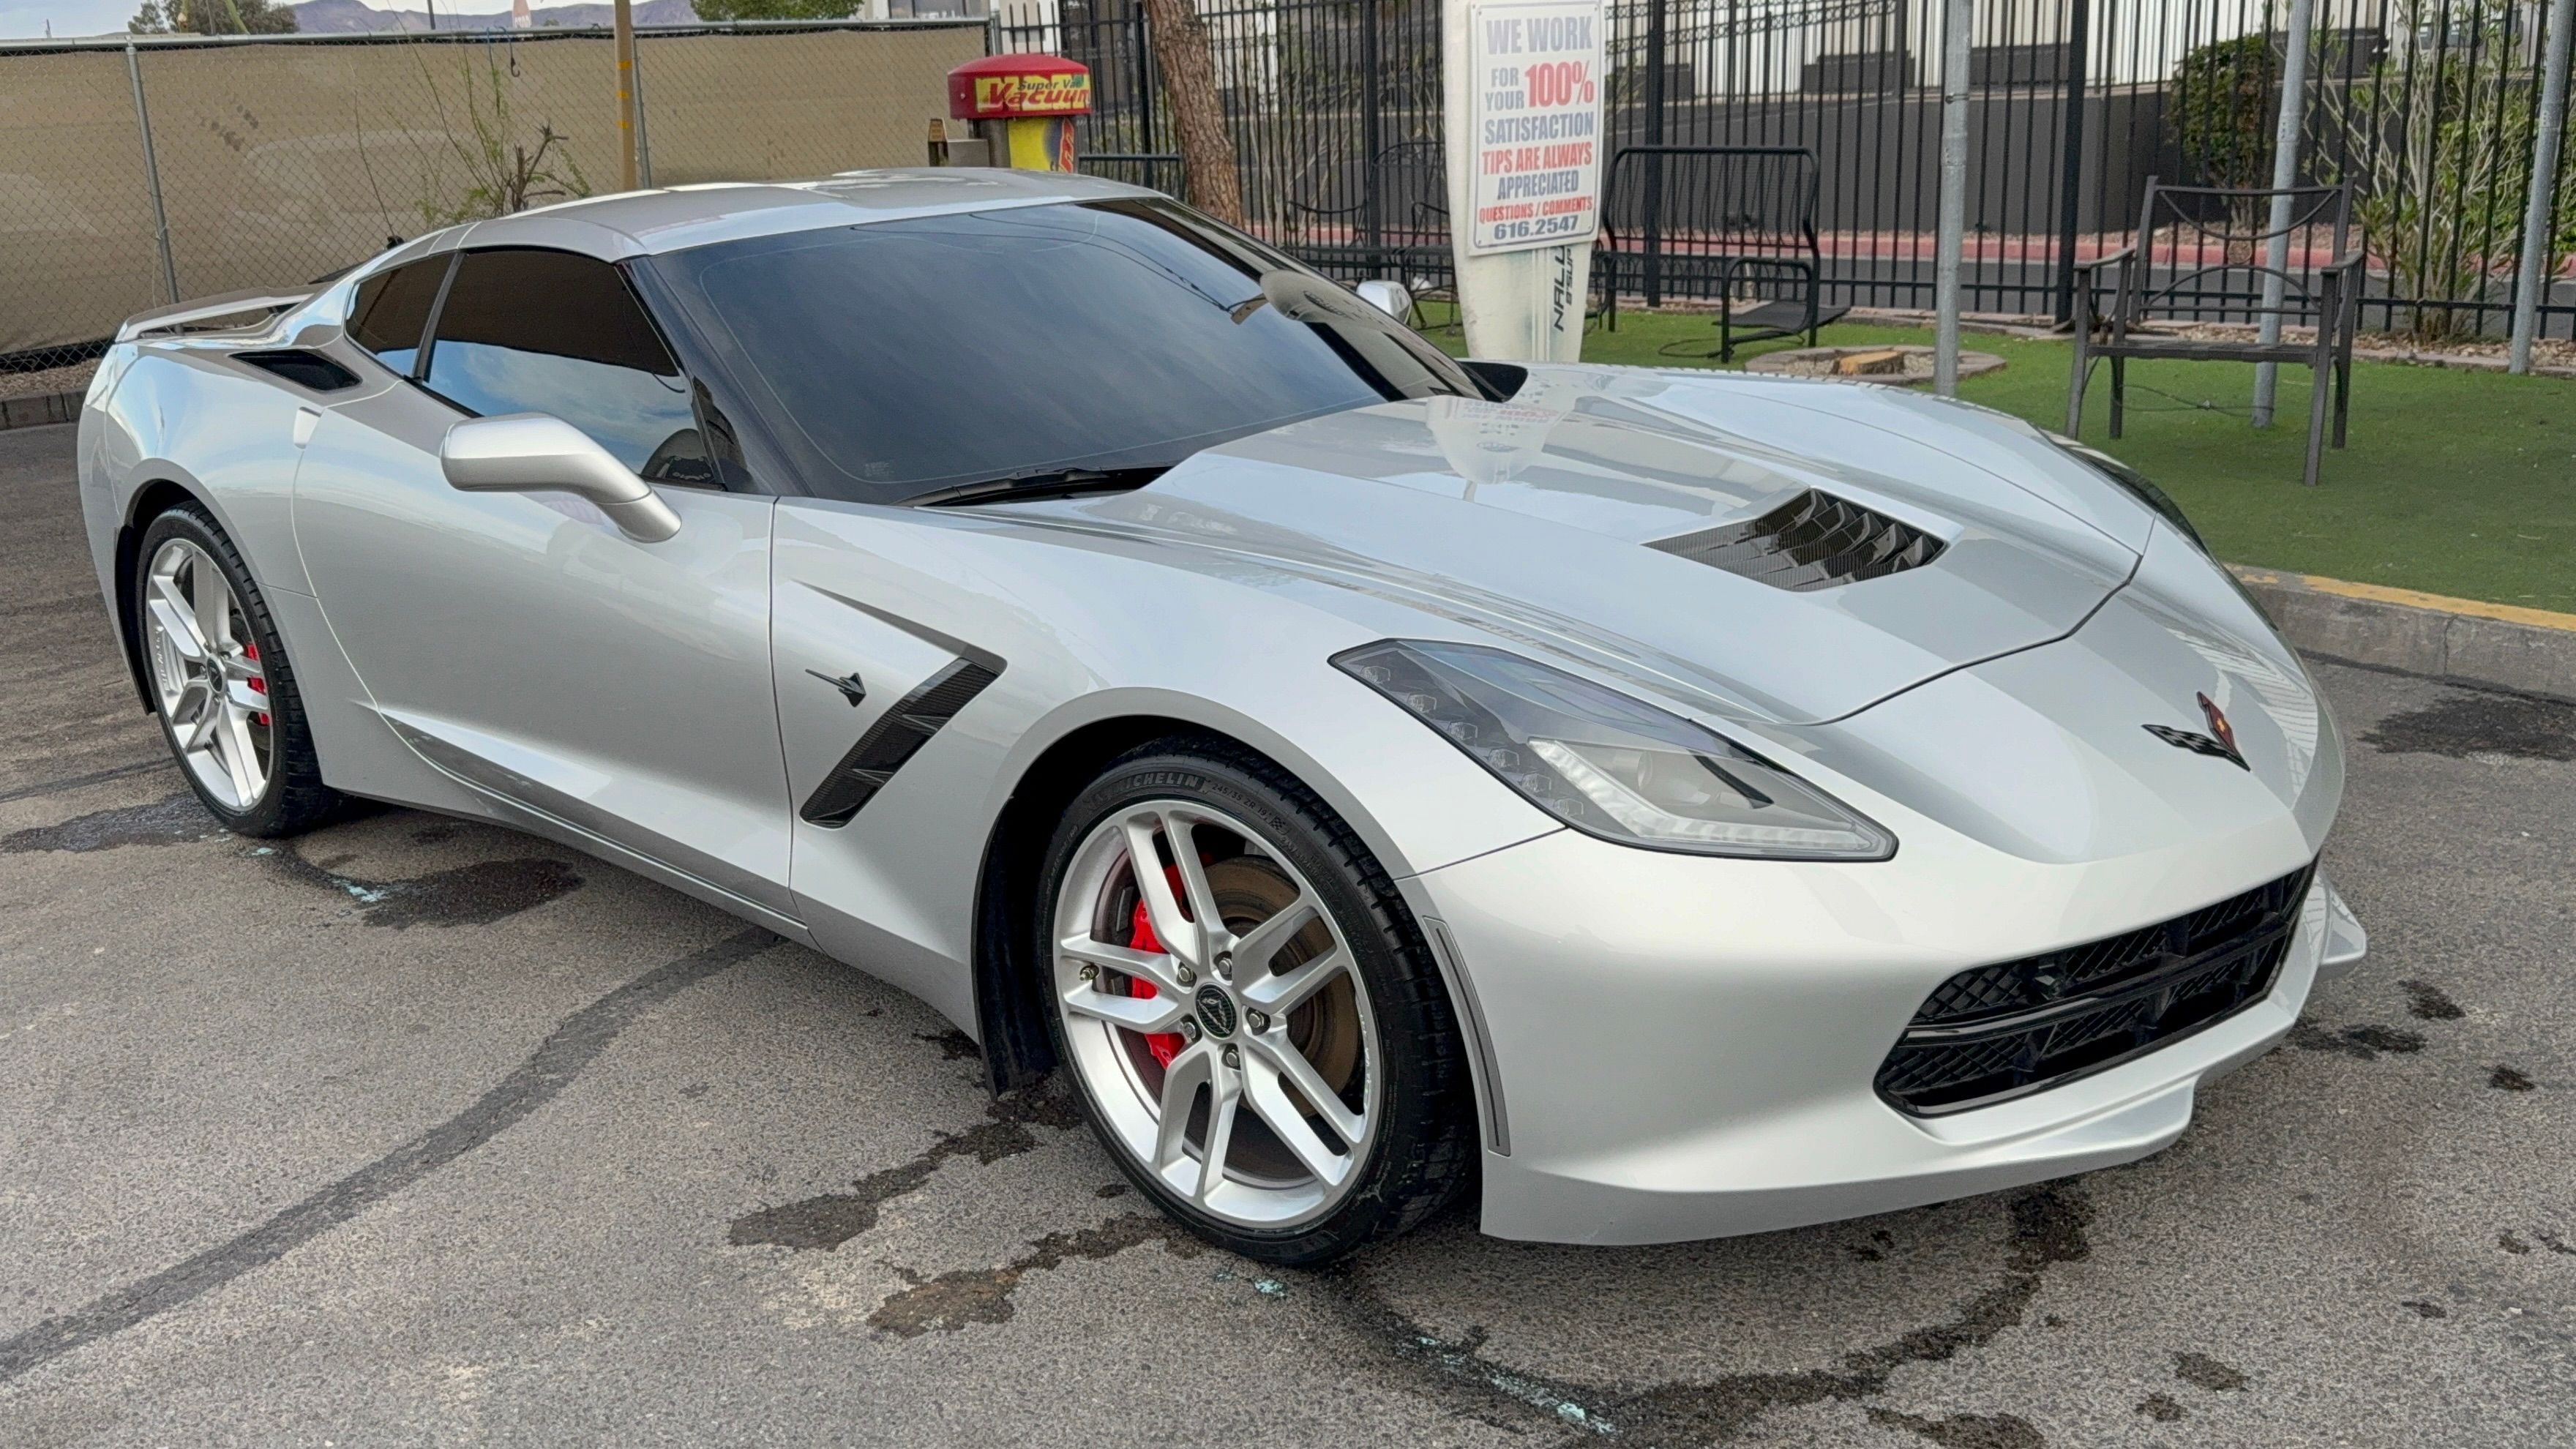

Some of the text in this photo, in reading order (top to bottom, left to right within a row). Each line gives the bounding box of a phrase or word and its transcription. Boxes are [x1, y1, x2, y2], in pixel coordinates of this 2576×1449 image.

[1486, 16, 1593, 55] WE WORK
[1017, 79, 1059, 91] Super
[1491, 67, 1519, 88] FOR
[1524, 59, 1595, 108] 100%
[1485, 90, 1525, 112] YOUR
[1485, 111, 1595, 145] SATISFACTION
[1482, 141, 1593, 176] TIPS ARE ALWAYS
[1497, 170, 1579, 201] APPRECIATED
[1479, 202, 1534, 224] QUESTIONS
[1542, 195, 1593, 216] COMMENTS
[1494, 214, 1579, 240] 616.2547
[1115, 772, 1199, 792] MICHELIN
[1244, 798, 1256, 809] ZR
